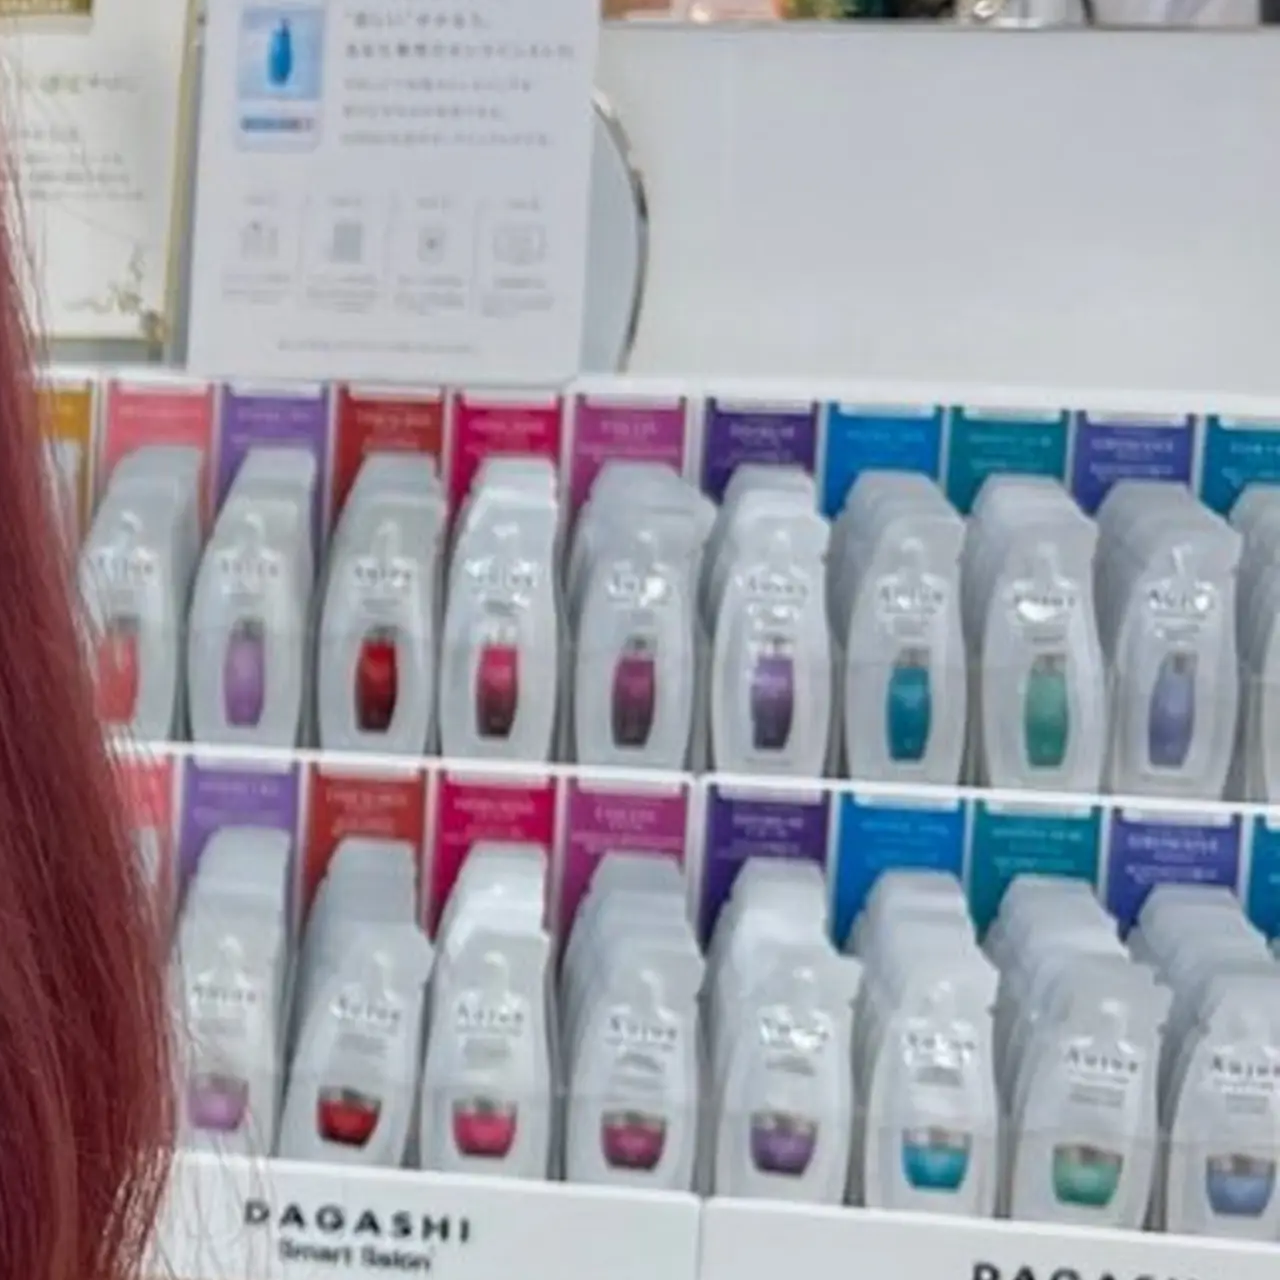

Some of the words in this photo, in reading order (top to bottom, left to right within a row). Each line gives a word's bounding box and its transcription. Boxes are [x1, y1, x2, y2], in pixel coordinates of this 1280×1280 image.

[243, 1200, 471, 1245] DAGASHI
[278, 1238, 352, 1267] Smart
[362, 1245, 432, 1272] Salon
